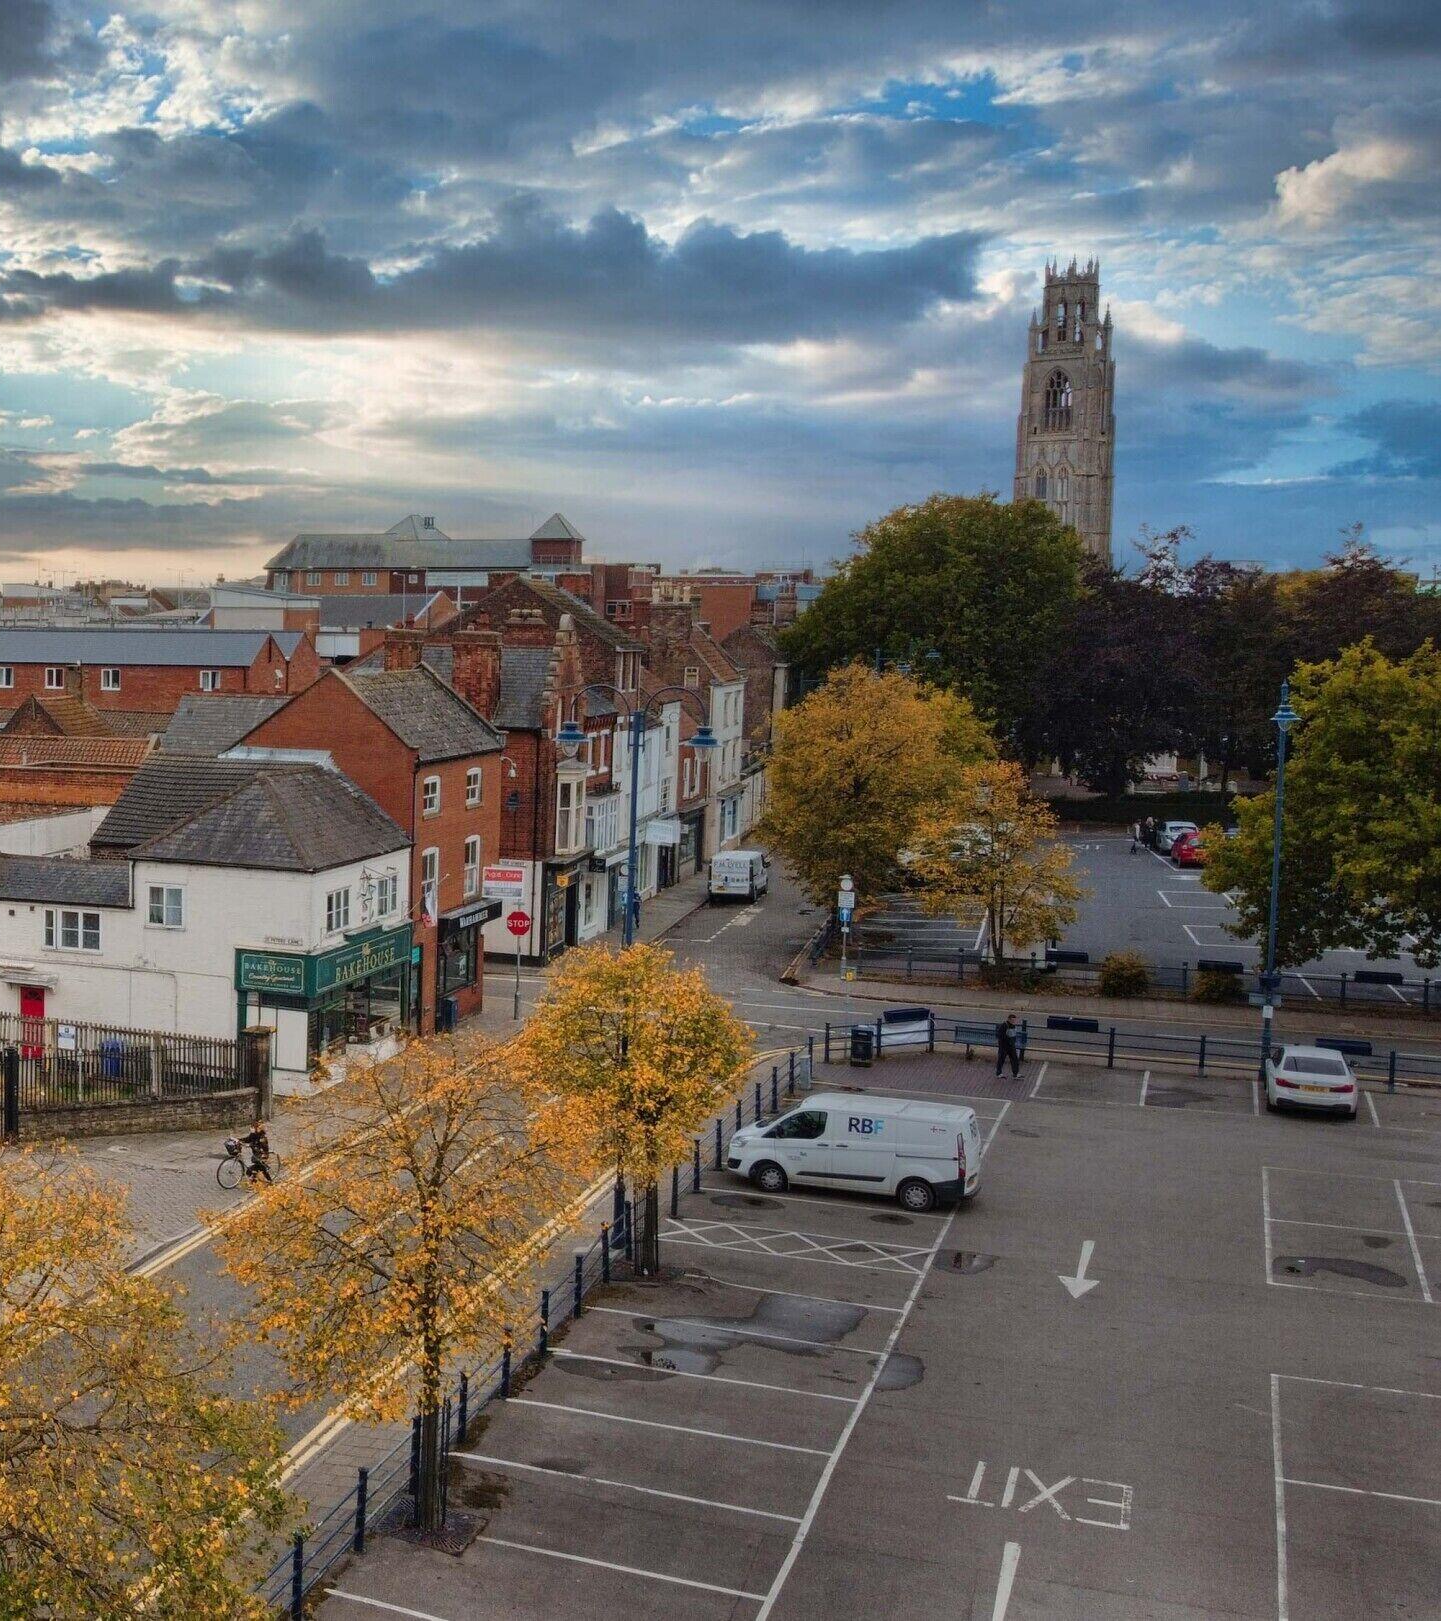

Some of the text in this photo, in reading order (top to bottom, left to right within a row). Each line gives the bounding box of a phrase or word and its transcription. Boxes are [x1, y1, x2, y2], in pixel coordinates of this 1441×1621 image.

[508, 919, 530, 928] STOP
[244, 962, 302, 975] BAKEHOUSE
[335, 947, 396, 982] BAKEHOUSE
[848, 1116, 885, 1135] RBF
[946, 1460, 1134, 1531] EXIT
